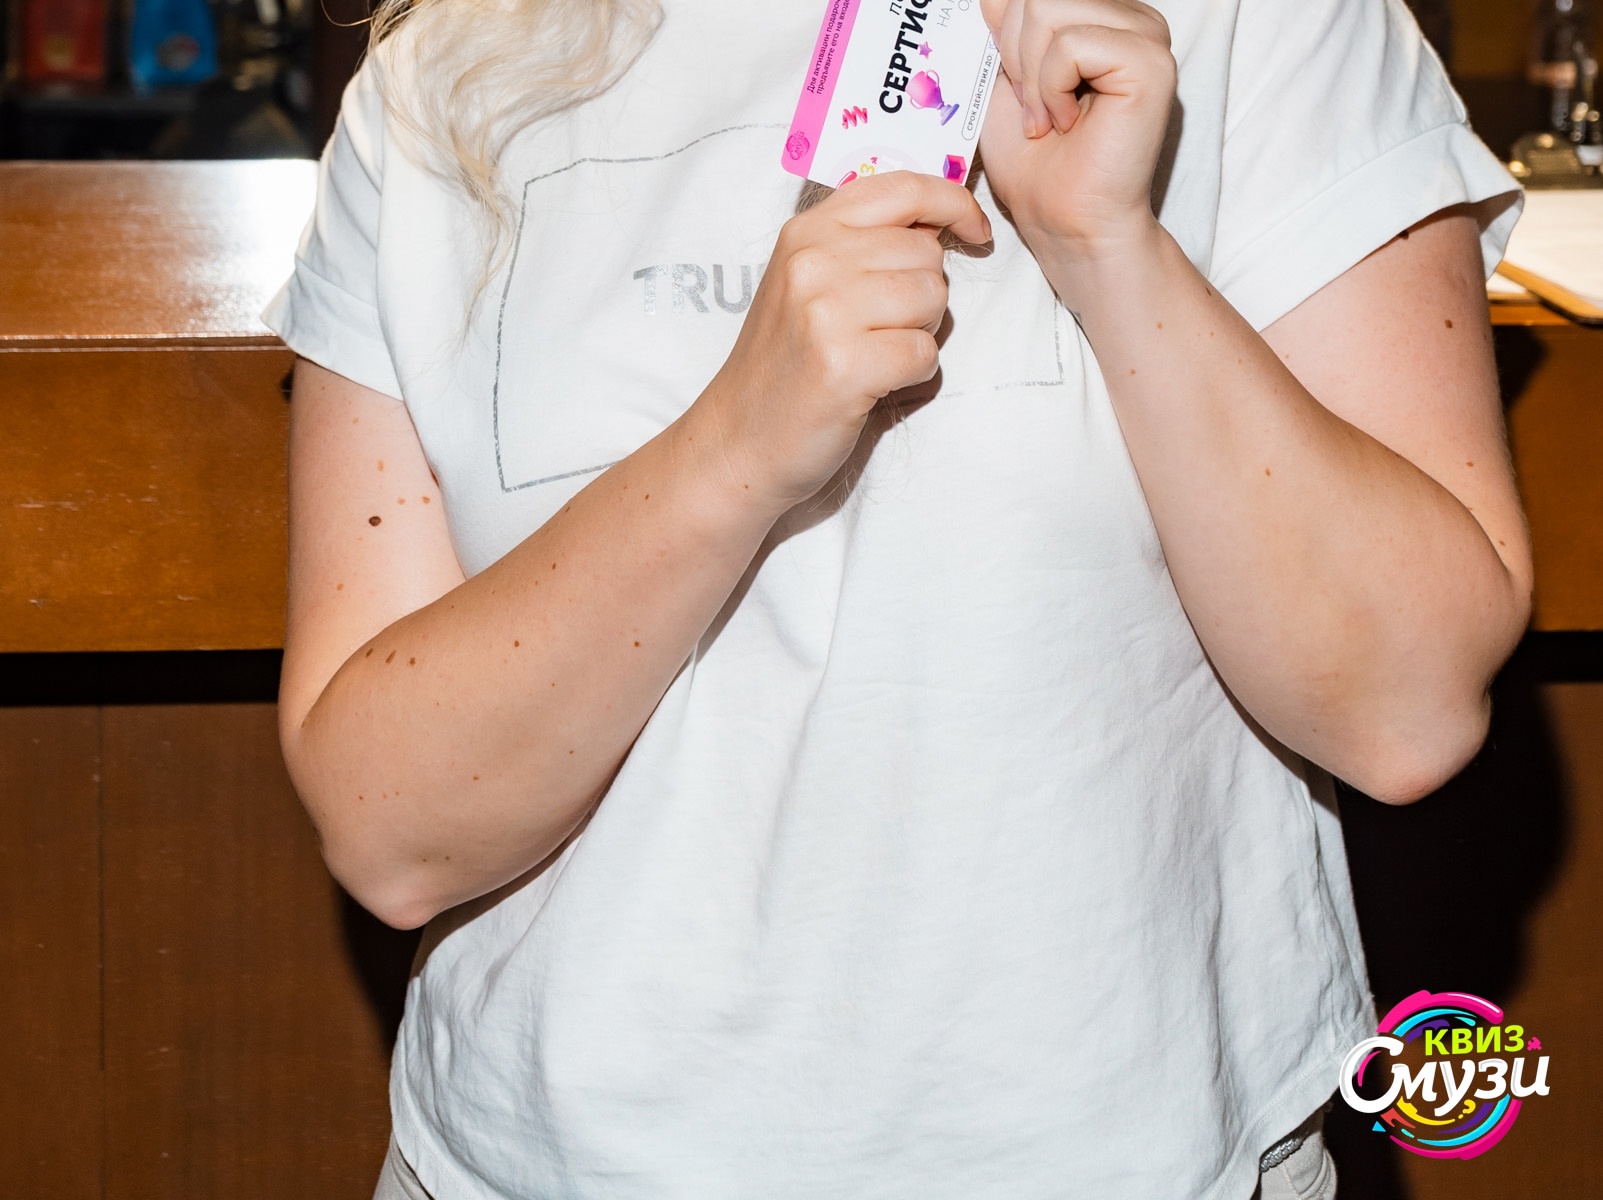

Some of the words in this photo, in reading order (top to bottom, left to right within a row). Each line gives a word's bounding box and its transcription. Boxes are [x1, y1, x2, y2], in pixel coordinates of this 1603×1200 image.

[936, 7, 953, 28] НА
[806, 76, 817, 94] Для
[813, 33, 831, 77] активации
[816, 47, 836, 95] предъявите
[830, 32, 840, 47] его
[835, 21, 843, 32] на
[966, 110, 977, 131] СРОК
[972, 67, 989, 110] ДЕЙСТВИЯ
[633, 263, 767, 315] TRU
